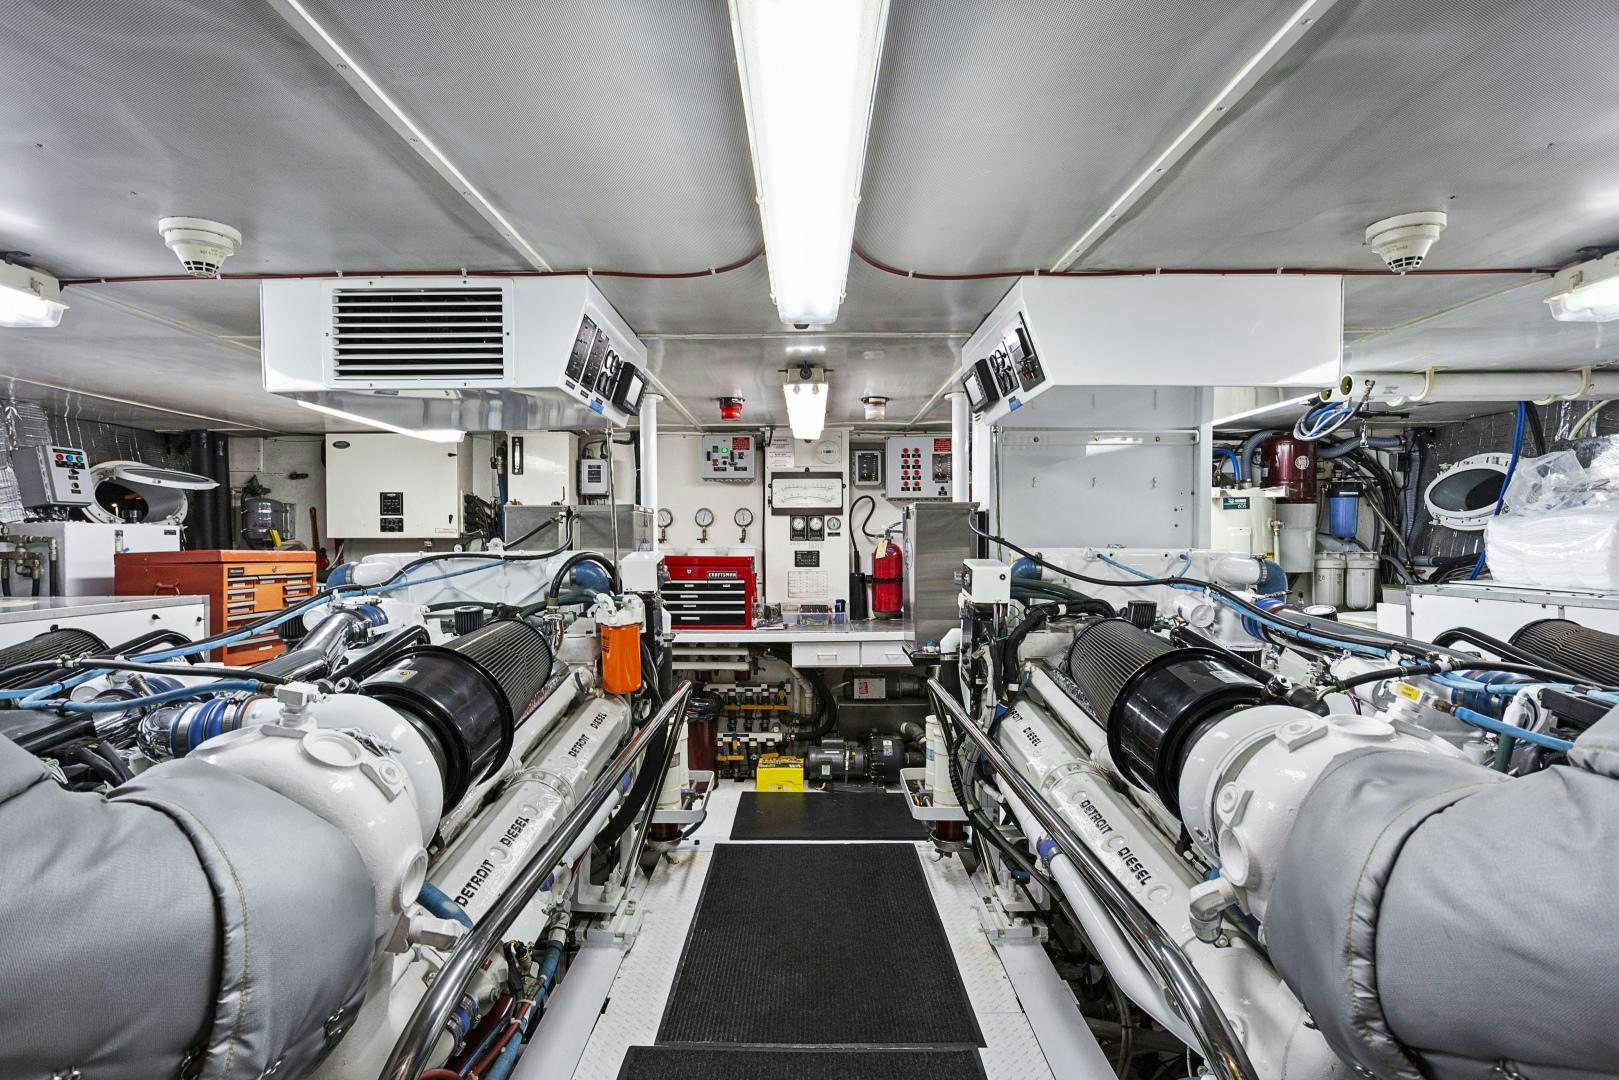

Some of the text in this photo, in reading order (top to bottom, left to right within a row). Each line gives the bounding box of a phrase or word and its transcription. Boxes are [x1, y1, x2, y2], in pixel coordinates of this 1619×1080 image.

[568, 712, 607, 758] DETROIT DIESEL
[1023, 727, 1041, 747] DIESEL
[454, 816, 530, 908] DETROIT DIESEL
[1079, 800, 1152, 886] DETROIT DIESEL
